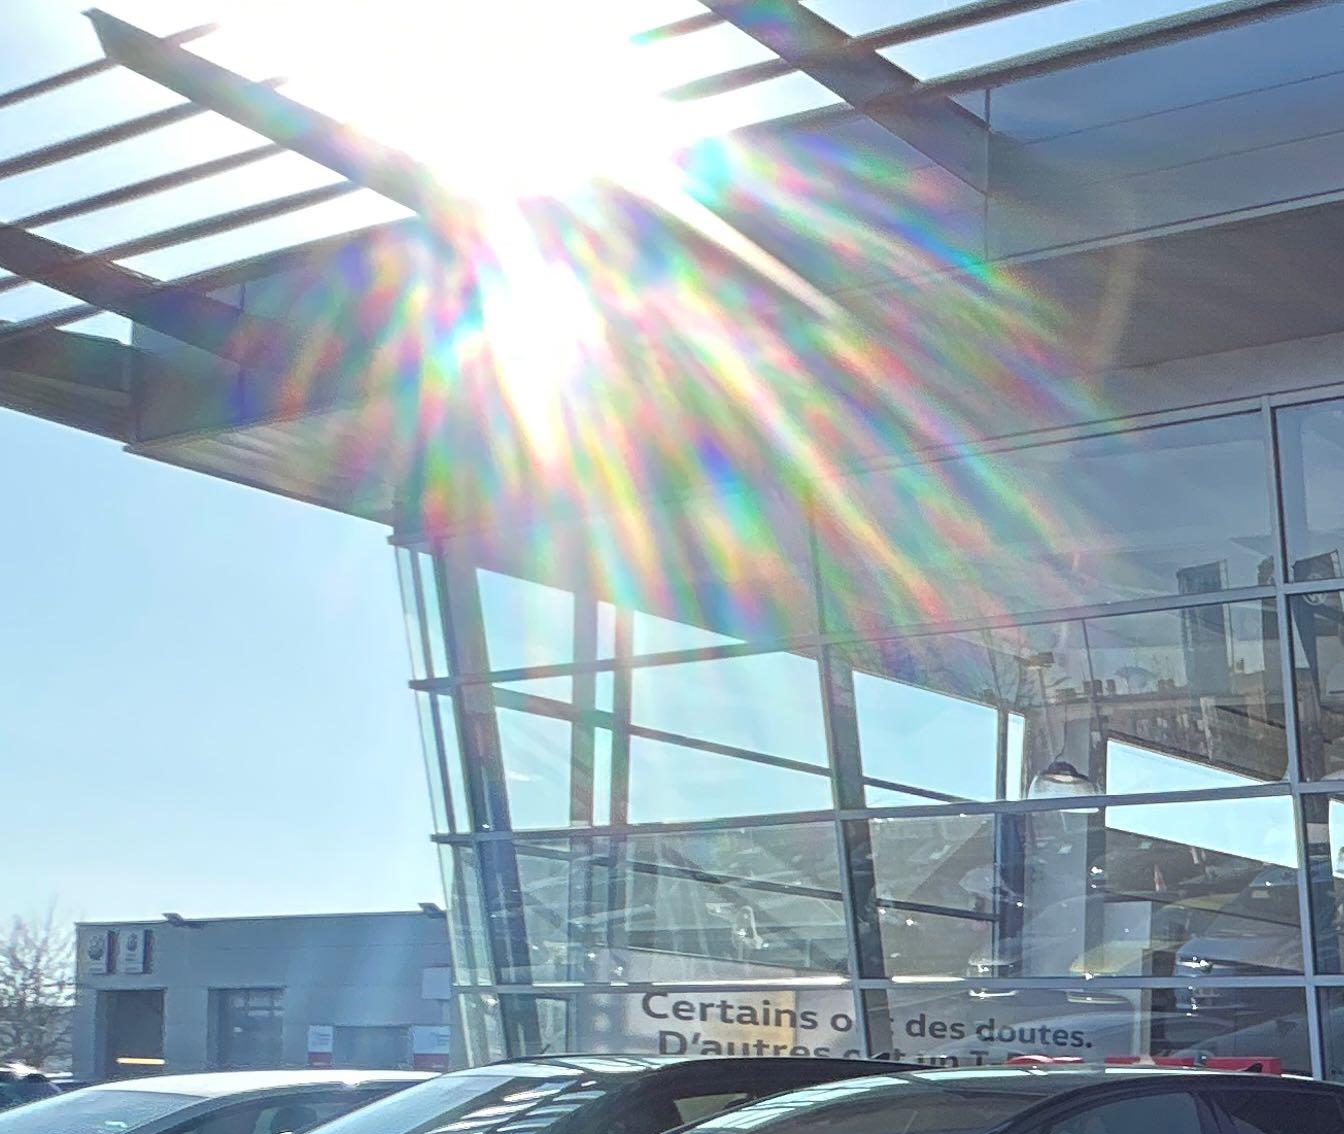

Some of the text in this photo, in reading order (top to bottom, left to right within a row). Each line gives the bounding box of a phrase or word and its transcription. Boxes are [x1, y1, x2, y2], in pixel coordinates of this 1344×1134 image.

[642, 992, 818, 1029] Certains
[905, 1013, 965, 1039] des
[976, 1018, 1092, 1048] doutes.
